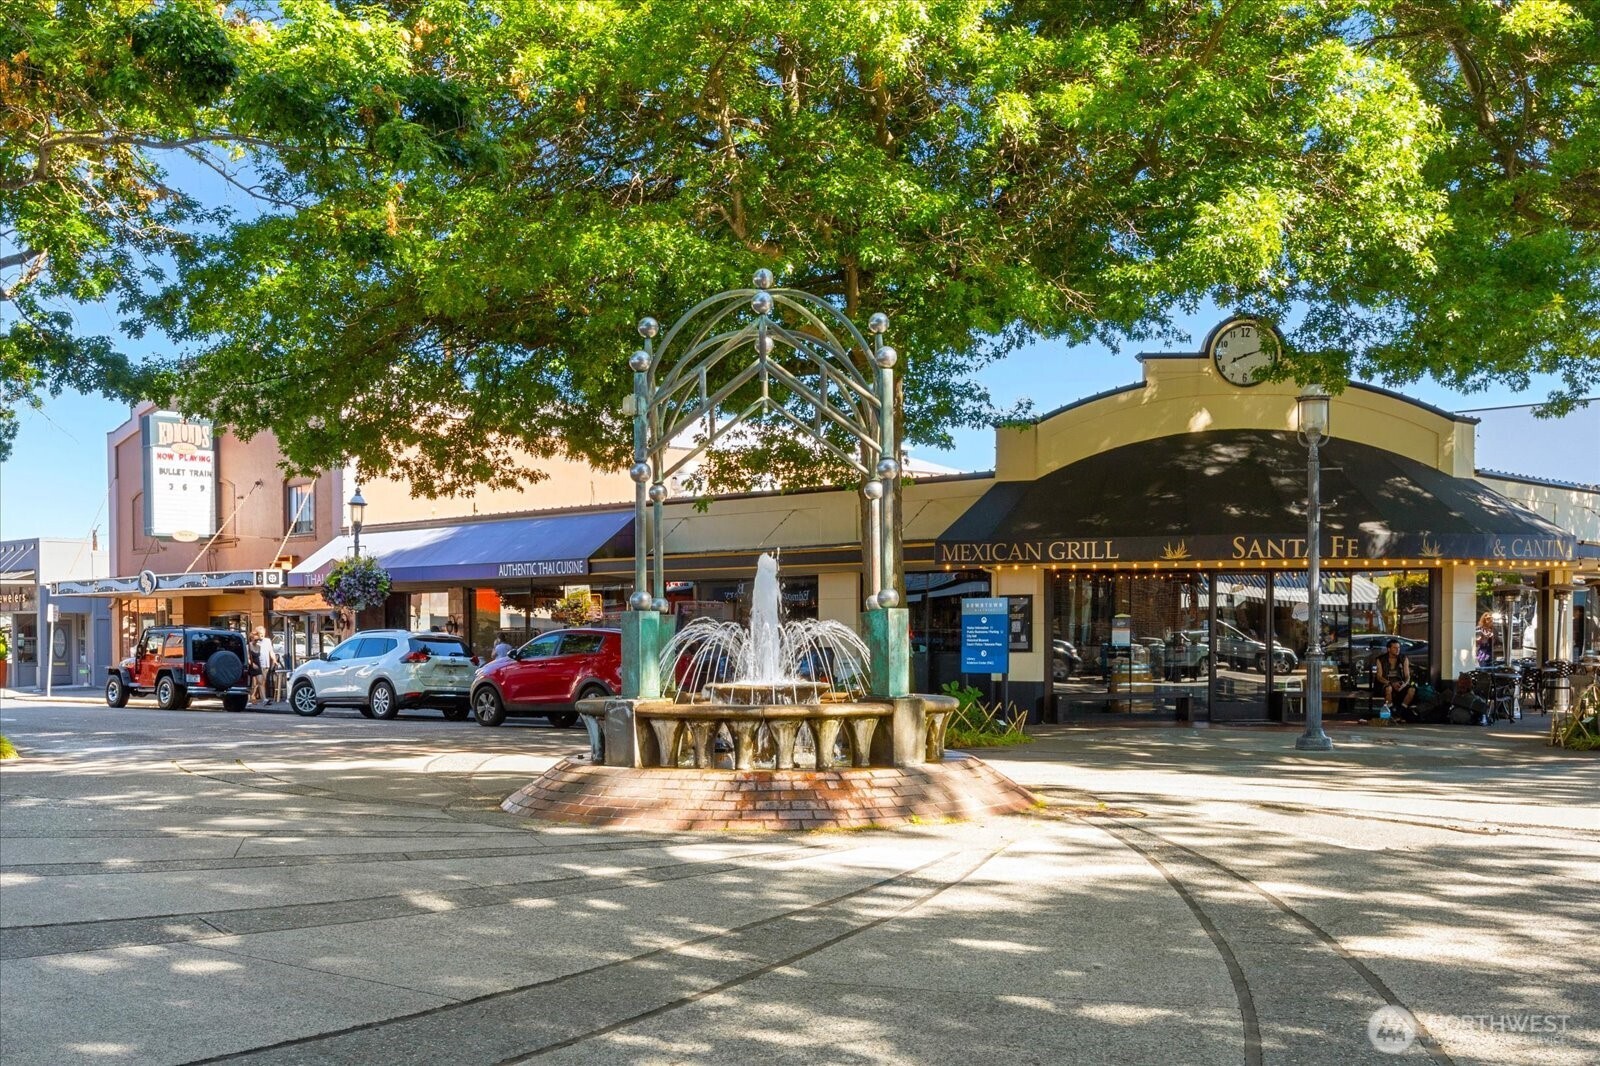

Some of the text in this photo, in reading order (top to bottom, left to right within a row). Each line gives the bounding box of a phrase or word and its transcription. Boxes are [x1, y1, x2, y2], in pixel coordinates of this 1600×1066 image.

[1230, 331, 1236, 339] 11
[1241, 328, 1250, 338] 12
[1242, 373, 1248, 383] 6
[158, 422, 210, 448] EDMONDS
[157, 453, 211, 463] NOW PLAYING
[158, 467, 213, 478] BULLET TRAIN
[940, 539, 1120, 562] MEXICAN GRILL
[1330, 535, 1359, 558] FE
[1492, 538, 1506, 557] &
[498, 560, 583, 577] AUTHENTIC THAI CUISINE
